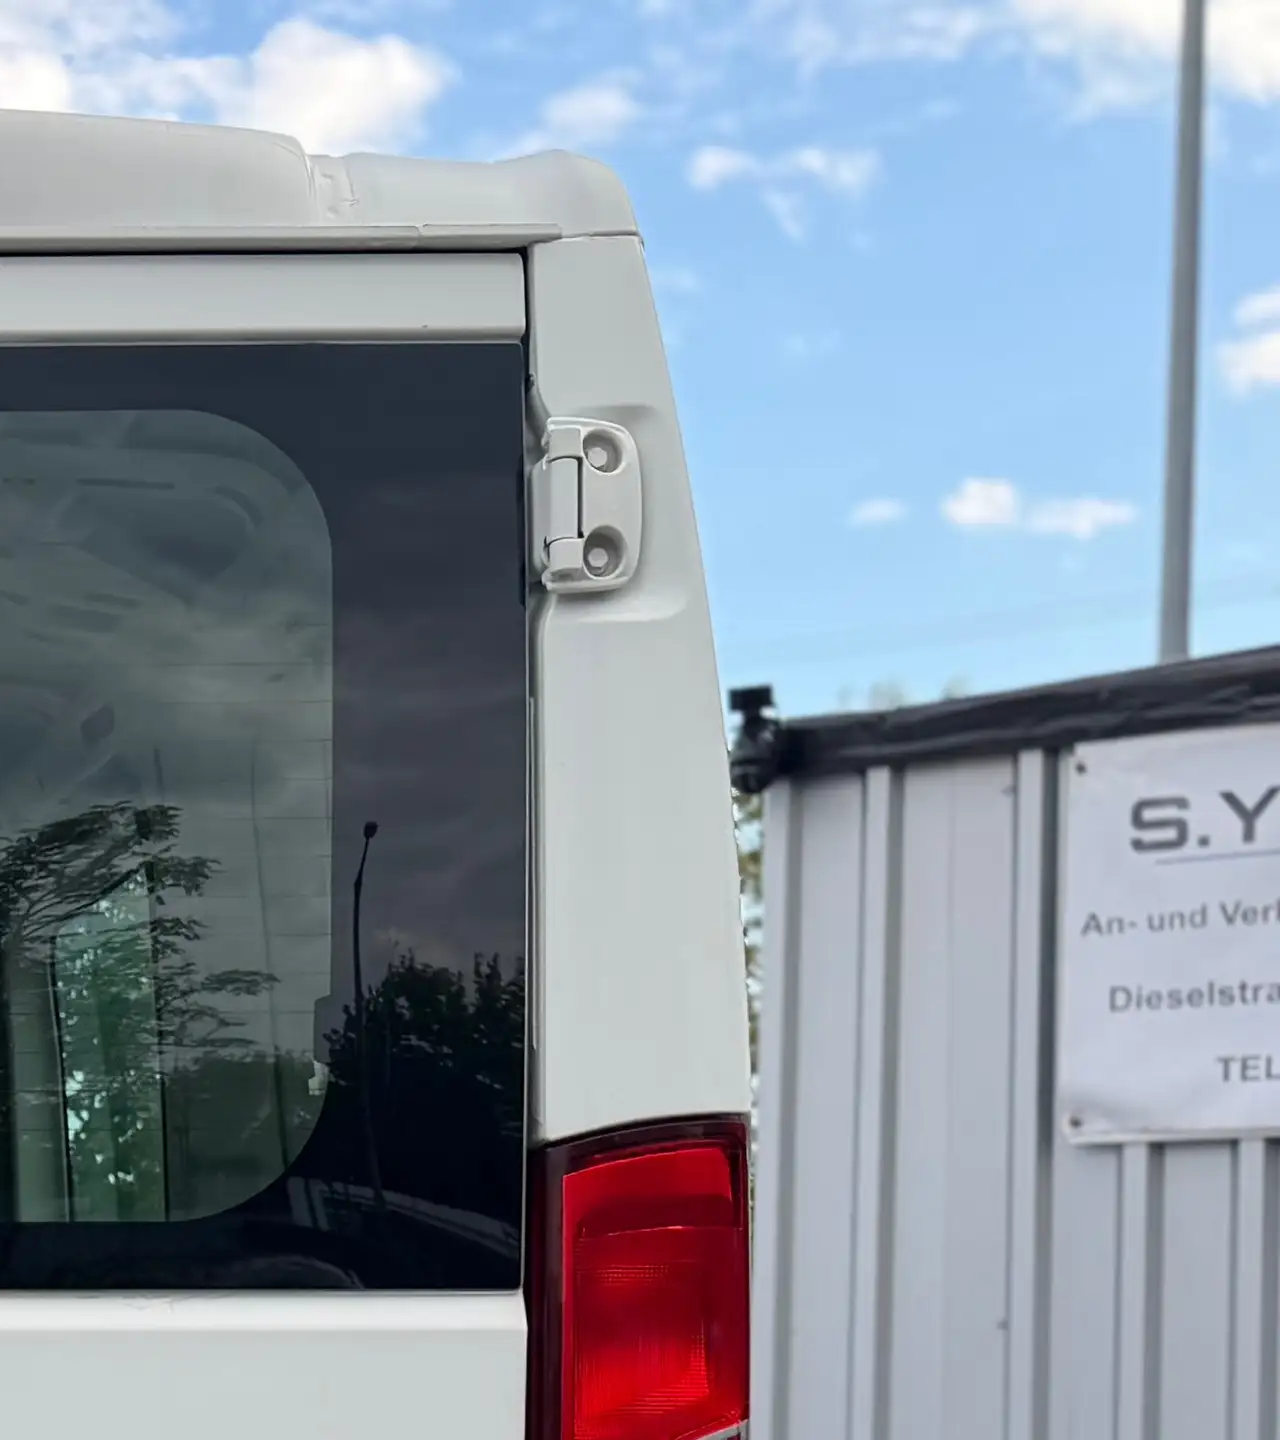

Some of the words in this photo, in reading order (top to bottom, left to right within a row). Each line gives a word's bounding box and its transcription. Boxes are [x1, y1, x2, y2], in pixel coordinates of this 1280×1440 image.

[1130, 785, 1280, 853] S.Y
[1080, 911, 1137, 937] An-
[1147, 902, 1208, 933] und
